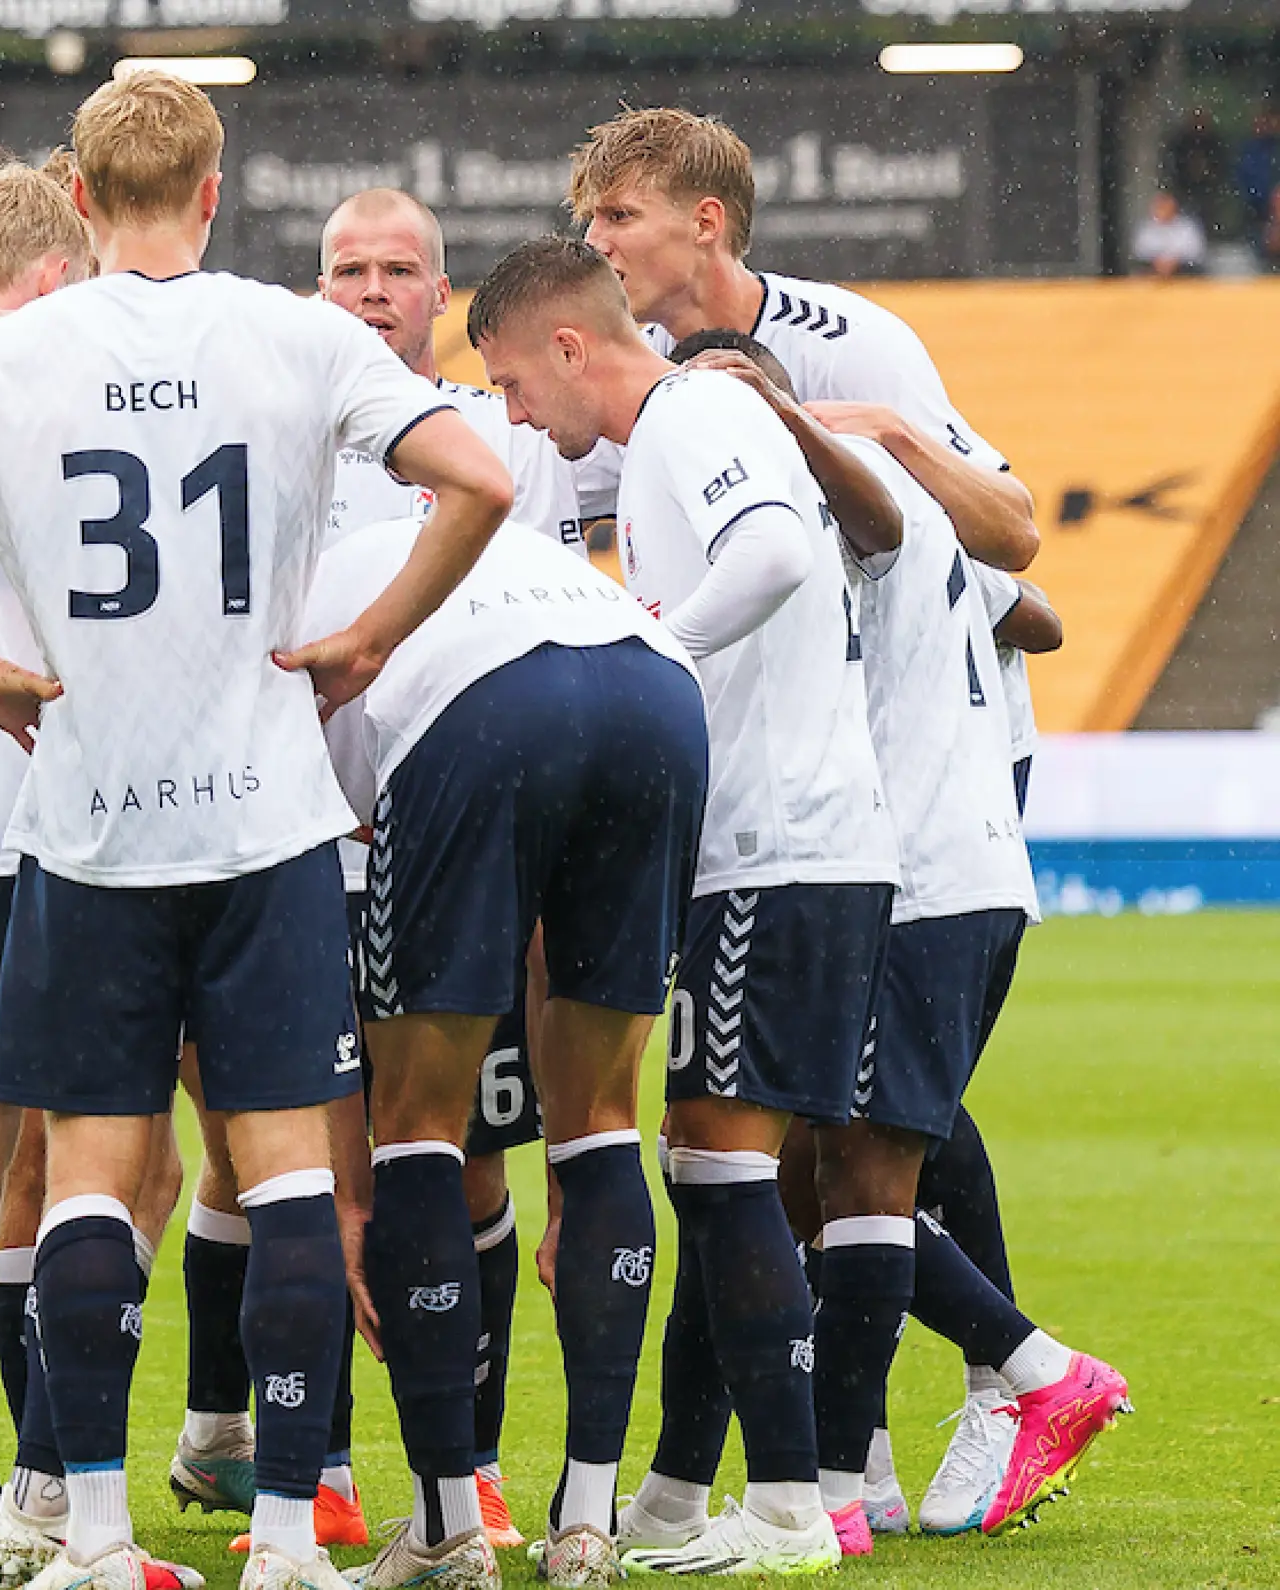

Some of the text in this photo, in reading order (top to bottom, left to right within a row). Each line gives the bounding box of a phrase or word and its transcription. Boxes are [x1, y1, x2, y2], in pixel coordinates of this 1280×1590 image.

[104, 379, 198, 412] BECH
[60, 442, 250, 618] 31
[89, 765, 261, 816] AARHUS
[481, 1047, 524, 1127] 6
